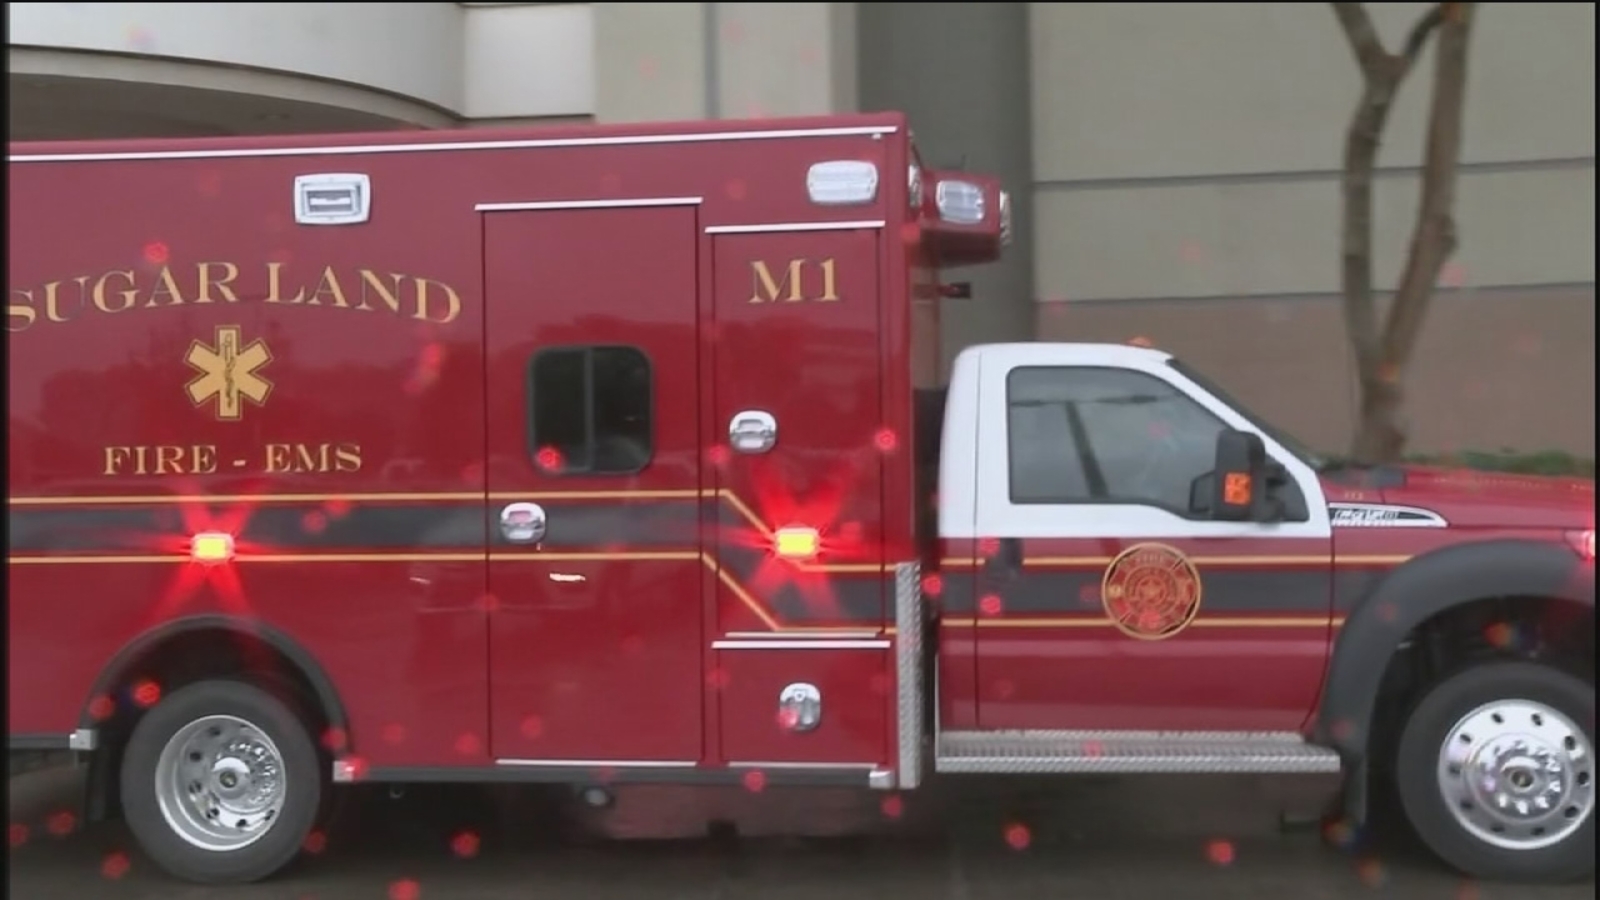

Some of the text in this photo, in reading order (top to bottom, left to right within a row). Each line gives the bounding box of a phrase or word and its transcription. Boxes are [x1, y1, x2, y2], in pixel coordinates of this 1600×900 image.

[8, 261, 461, 331] SUGAR LAND
[749, 258, 840, 303] M1
[103, 446, 217, 474] FIRE
[263, 443, 362, 473] EMS
